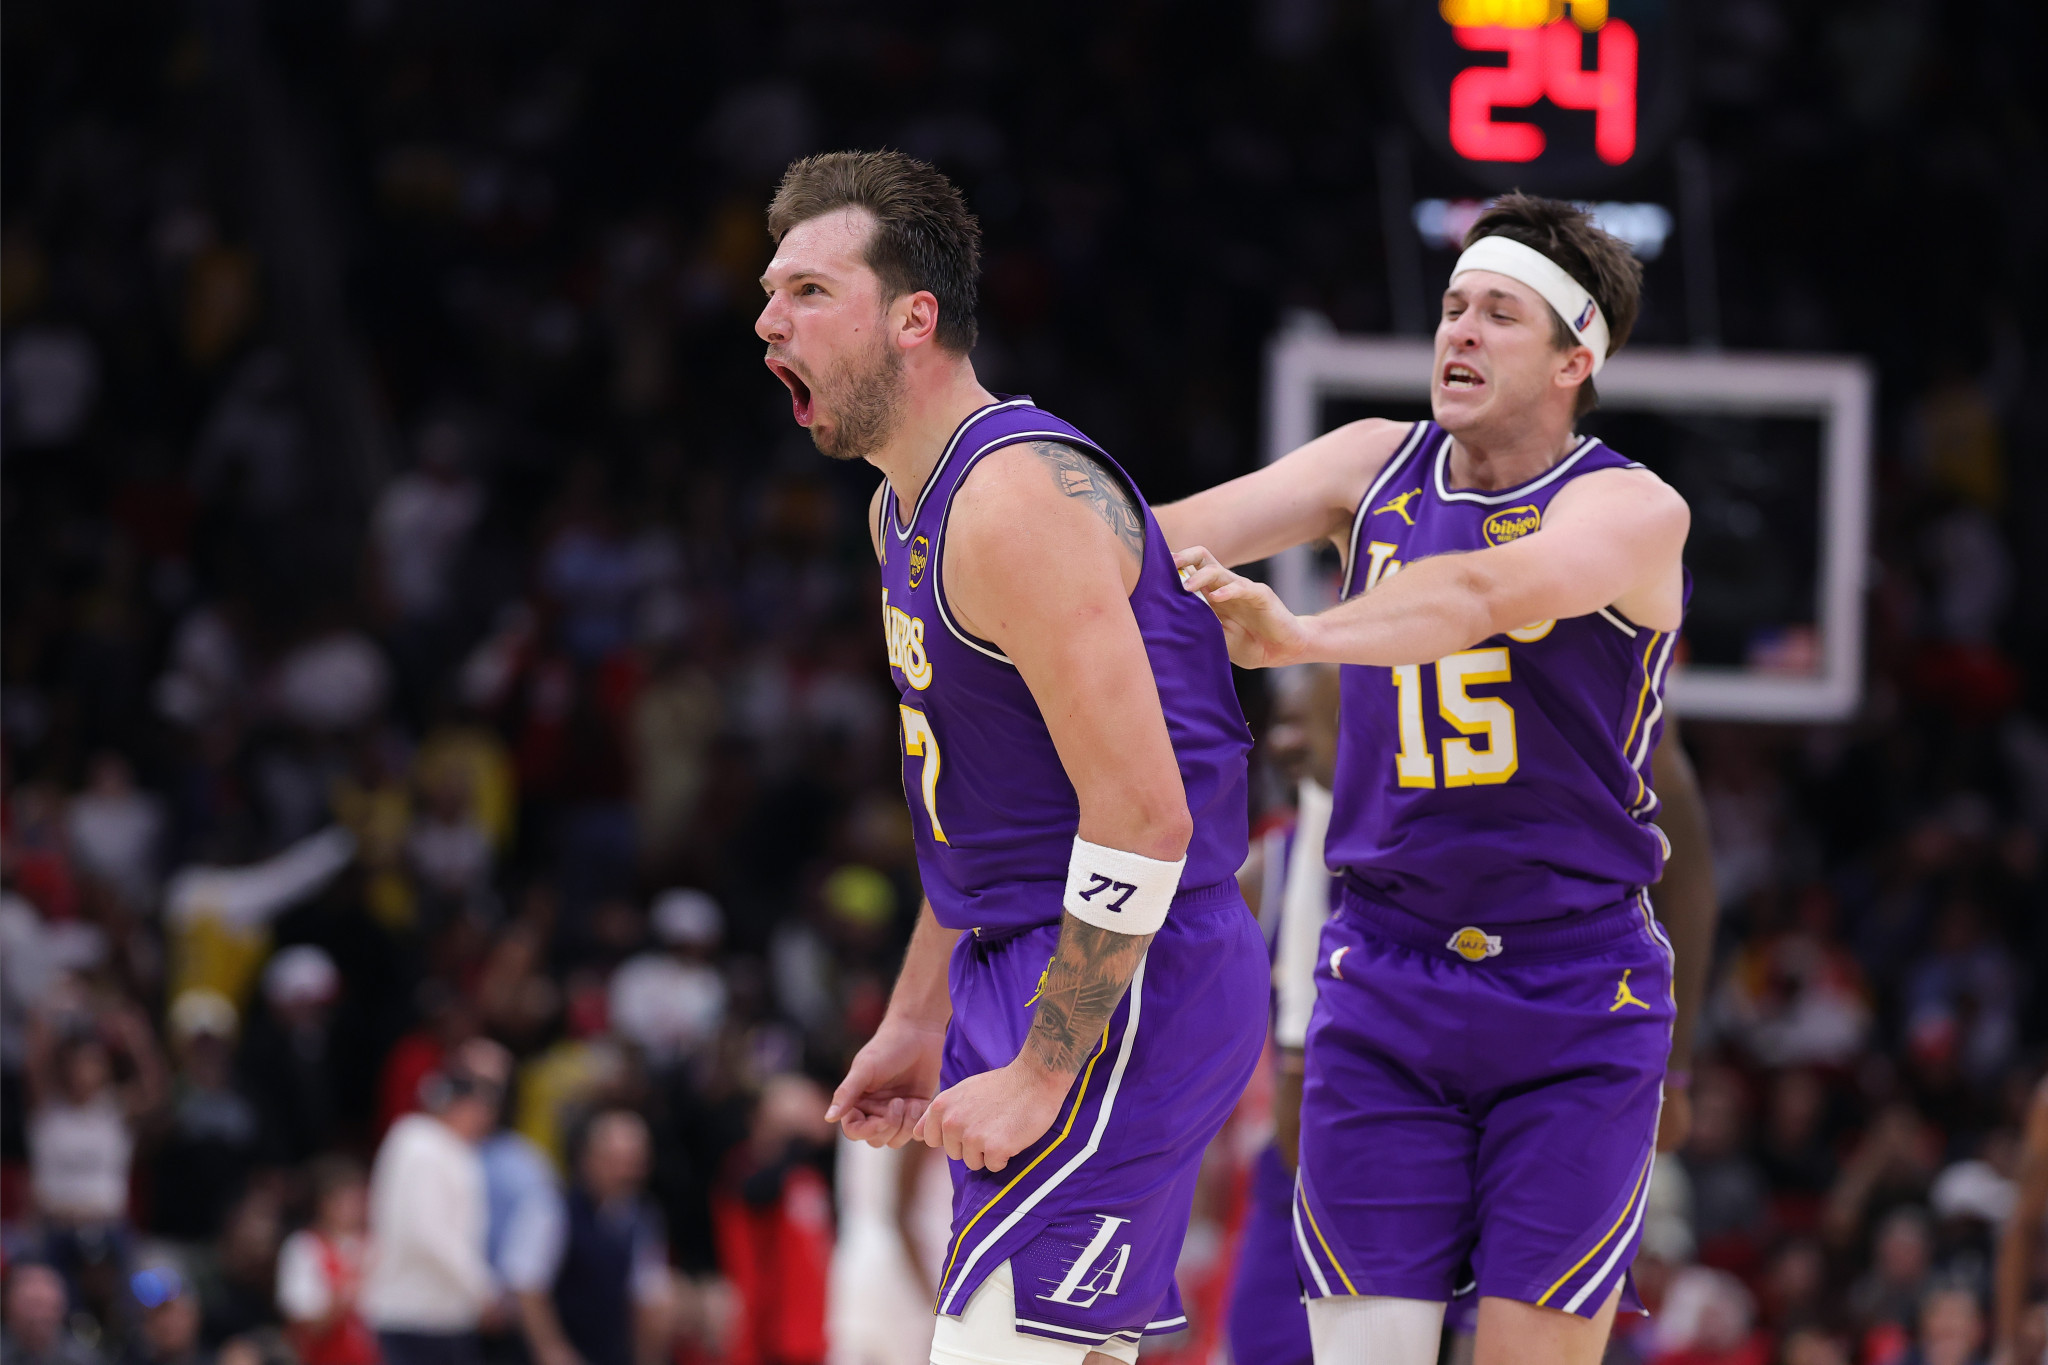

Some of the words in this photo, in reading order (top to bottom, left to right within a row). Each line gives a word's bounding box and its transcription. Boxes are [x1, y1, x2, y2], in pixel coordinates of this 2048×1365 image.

[1449, 15, 1638, 166] 24
[1489, 517, 1536, 536] bibigo
[899, 703, 950, 847] 7
[1392, 646, 1518, 789] 15
[1079, 873, 1137, 913] 77
[1035, 1213, 1131, 1308] LA
